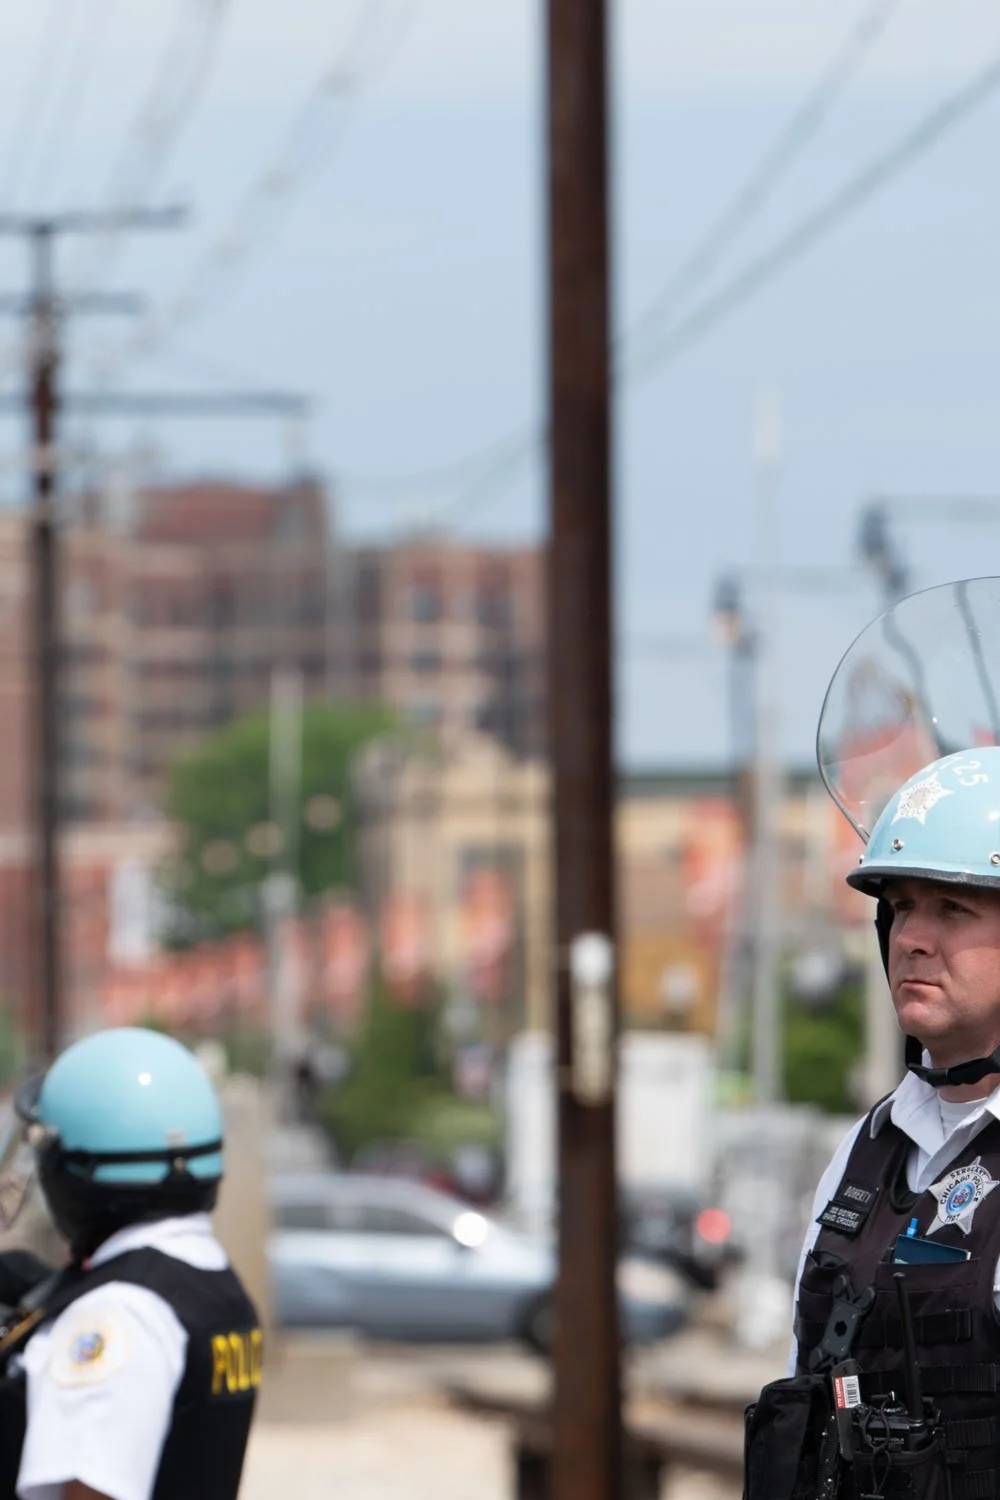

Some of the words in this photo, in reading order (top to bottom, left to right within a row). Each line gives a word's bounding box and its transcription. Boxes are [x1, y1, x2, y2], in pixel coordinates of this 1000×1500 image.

[940, 1174, 971, 1205] CHICAGO
[971, 1175, 982, 1203] POLICE
[211, 1328, 263, 1396] POLIC
